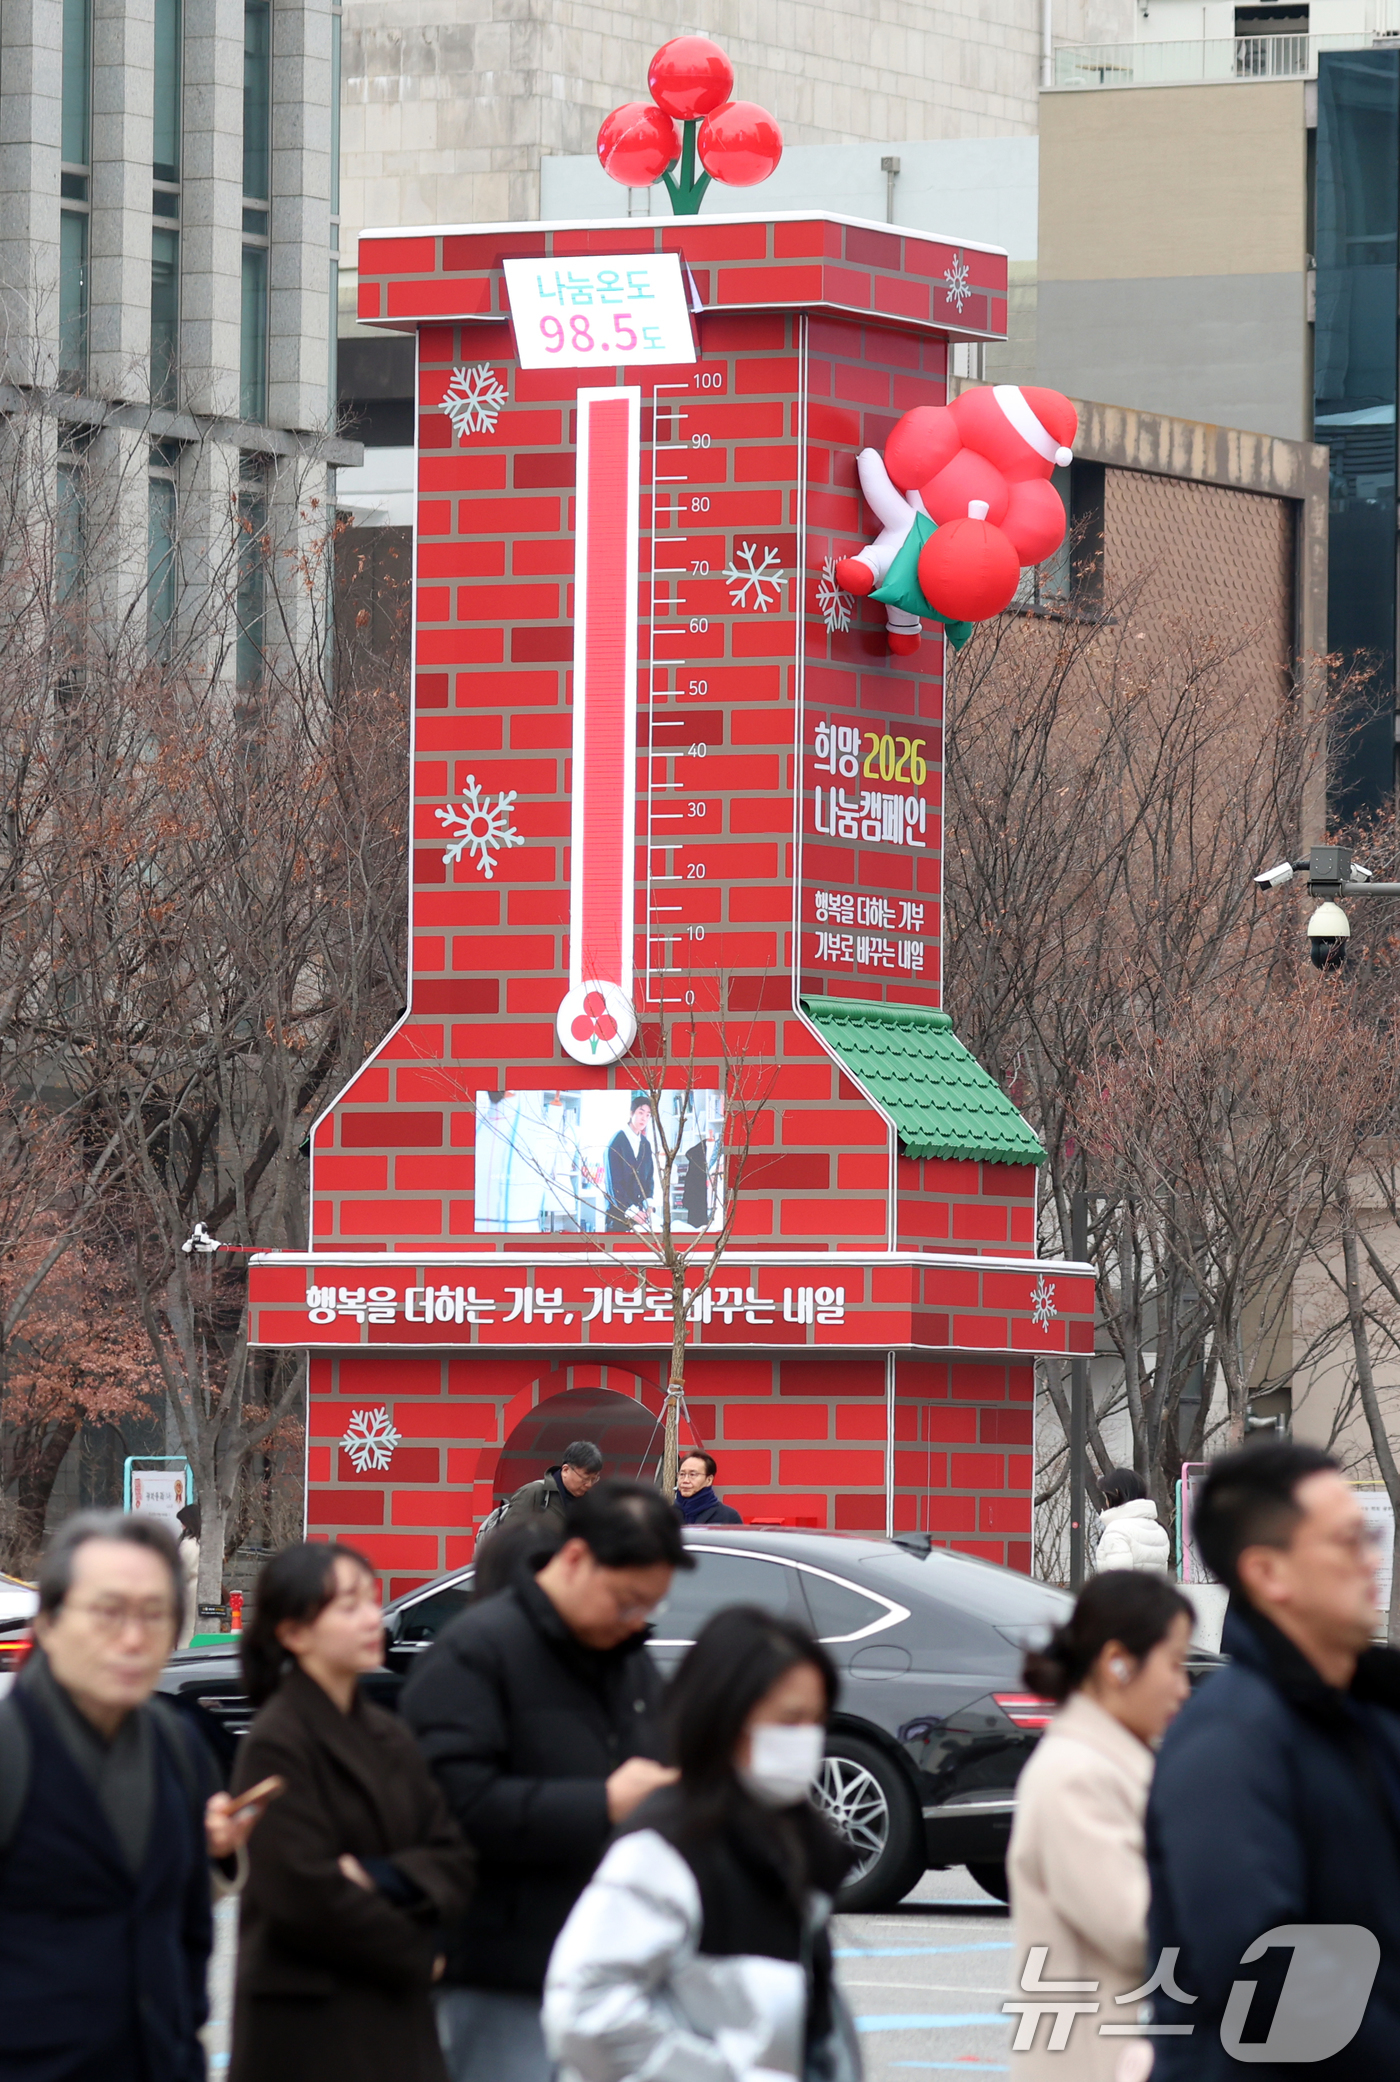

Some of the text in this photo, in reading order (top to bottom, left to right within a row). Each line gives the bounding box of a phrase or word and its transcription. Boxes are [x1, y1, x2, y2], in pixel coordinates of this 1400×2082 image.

[536, 270, 656, 306] 나눔온도
[693, 372, 722, 389] 100
[691, 433, 711, 450] 90
[691, 496, 710, 513] 80
[690, 560, 709, 577] 70
[689, 617, 709, 634] 60
[688, 680, 708, 696] 50
[687, 742, 707, 759] 40
[687, 801, 706, 818] 30
[814, 785, 926, 848] 나눔캠페인
[686, 863, 706, 879] 20
[814, 890, 925, 932] 행복을 더하는 기부
[686, 925, 705, 942] 10
[814, 931, 924, 971] 기부로 바꾸는 내일
[685, 989, 695, 1006] 0
[305, 1285, 845, 1325] 행복을 더하는 기부, 기부로 바꾸는 내일
